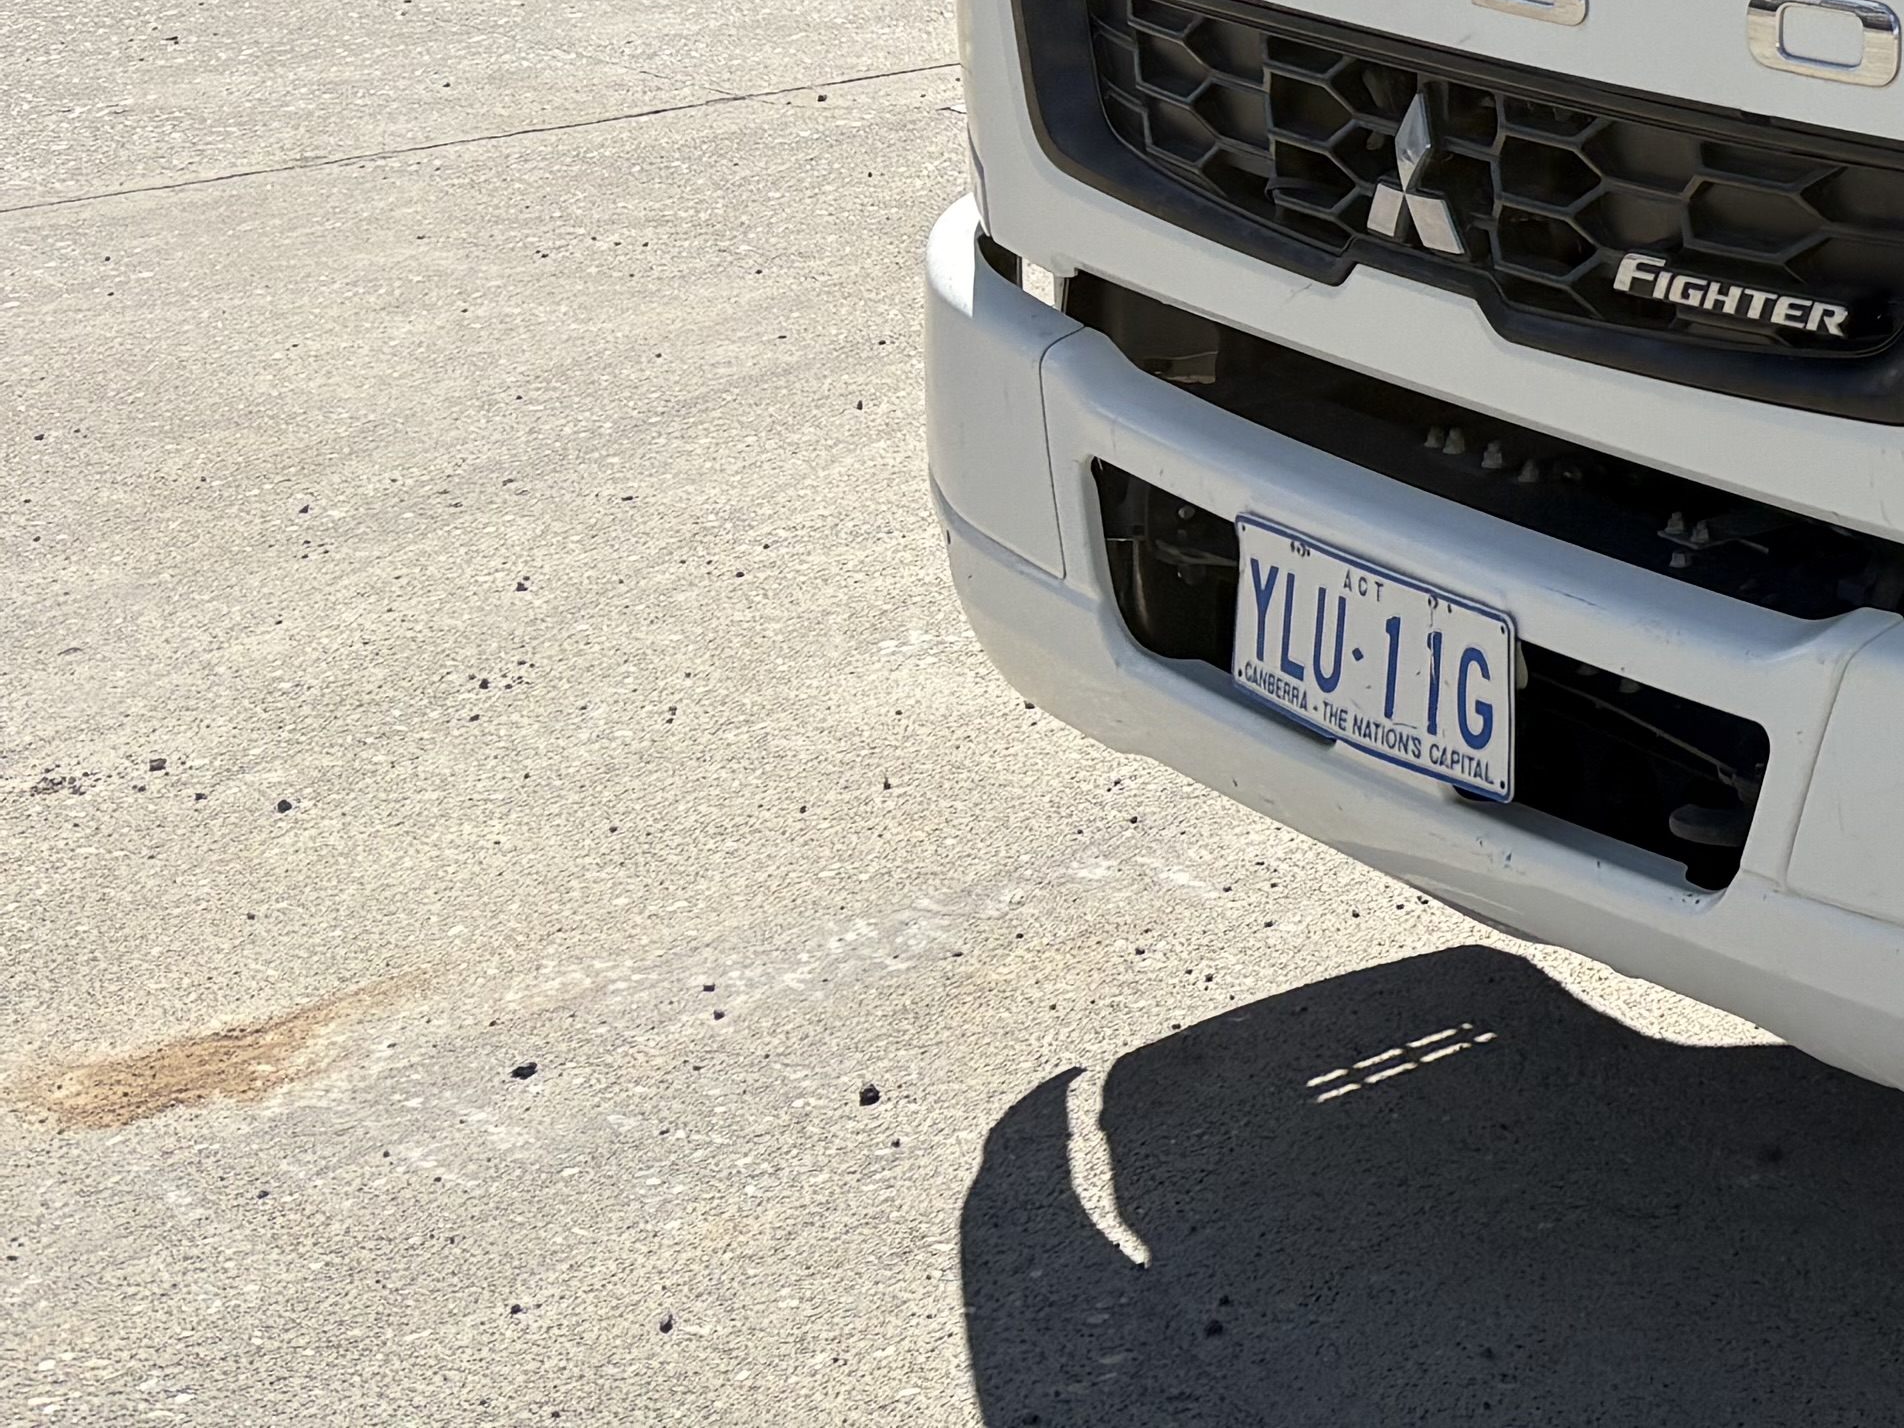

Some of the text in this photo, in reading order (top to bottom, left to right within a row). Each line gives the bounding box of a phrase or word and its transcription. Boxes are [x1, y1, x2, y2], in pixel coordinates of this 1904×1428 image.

[1613, 253, 1850, 339] FIGHTER
[1343, 569, 1384, 602] ACT
[1244, 660, 1309, 712] CANBERRA
[1322, 700, 1348, 732] THE
[1429, 742, 1495, 785] CAPITAL
